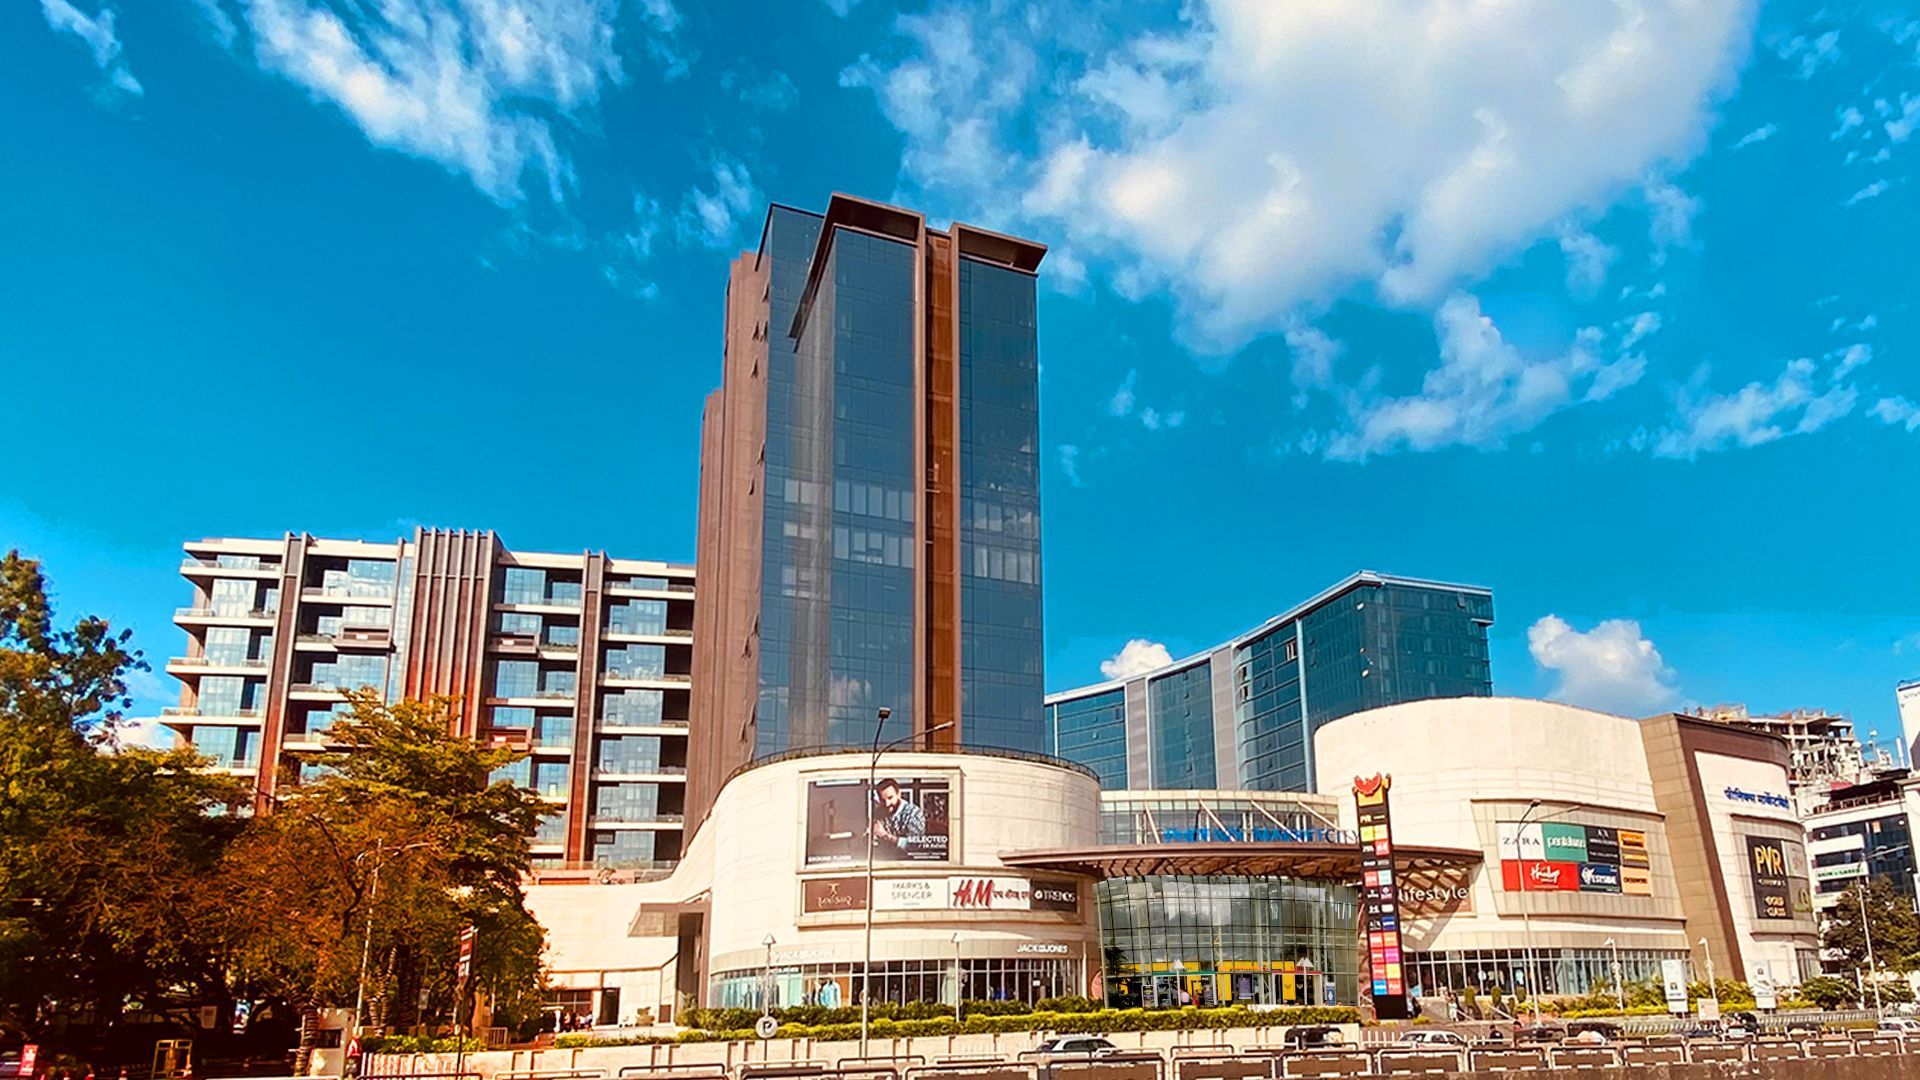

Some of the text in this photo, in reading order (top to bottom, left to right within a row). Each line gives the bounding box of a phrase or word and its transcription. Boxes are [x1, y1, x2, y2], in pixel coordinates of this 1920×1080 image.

[907, 836, 948, 844] SELECTED
[1754, 845, 1783, 875] PVR
[893, 882, 923, 890] MARKS
[892, 892, 932, 900] SPENCER
[953, 880, 994, 907] H&M
[1043, 890, 1076, 902] TRENDS
[1398, 884, 1468, 903] lifestyle
